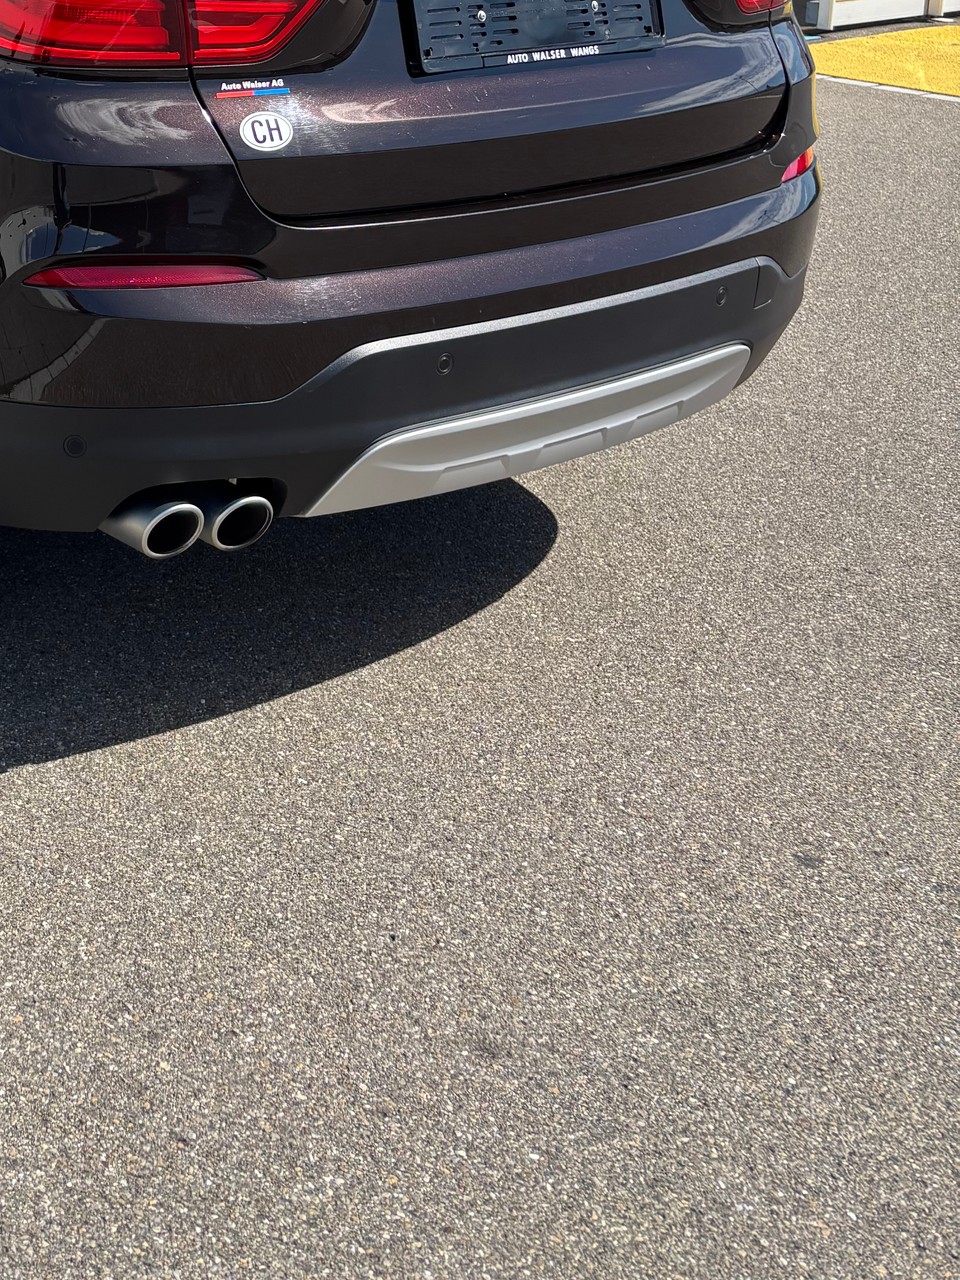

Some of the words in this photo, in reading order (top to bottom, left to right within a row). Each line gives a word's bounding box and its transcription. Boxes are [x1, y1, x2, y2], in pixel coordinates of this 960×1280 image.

[507, 53, 529, 65] AUTO
[532, 49, 566, 61] WALSER
[570, 45, 600, 57] WANGS
[221, 82, 242, 91] Auto
[271, 78, 284, 87] AG
[250, 118, 284, 144] CH
